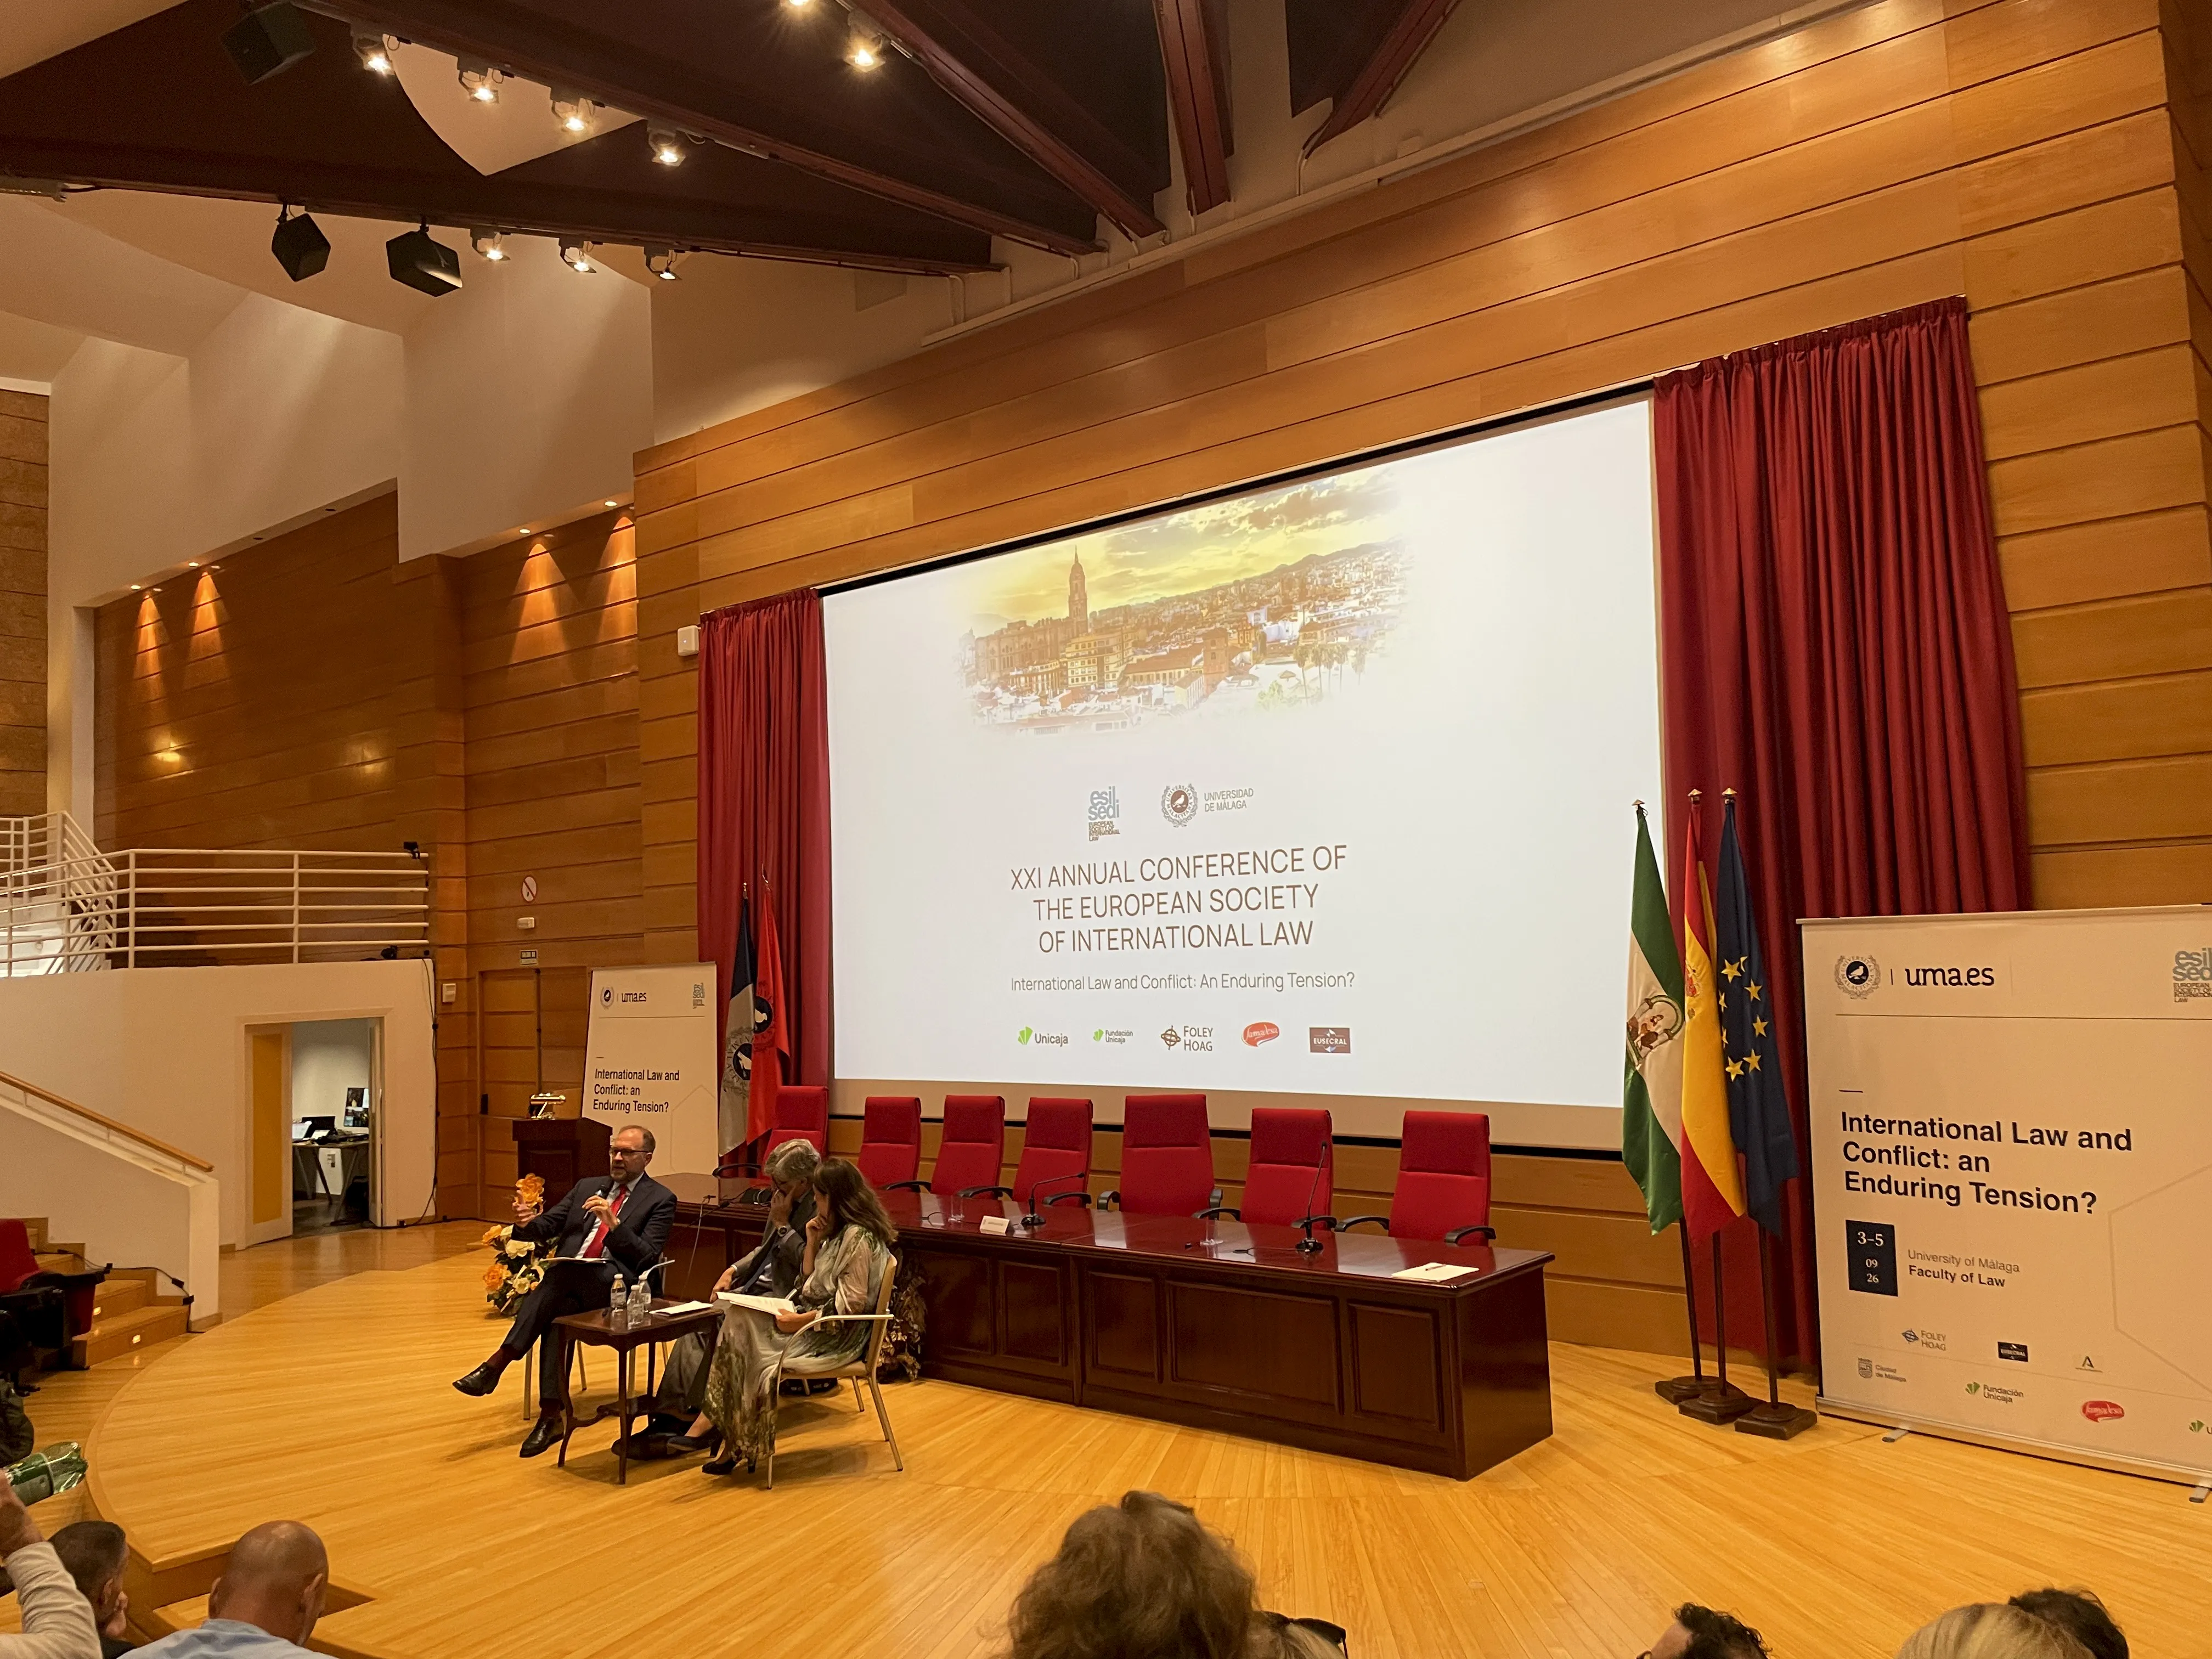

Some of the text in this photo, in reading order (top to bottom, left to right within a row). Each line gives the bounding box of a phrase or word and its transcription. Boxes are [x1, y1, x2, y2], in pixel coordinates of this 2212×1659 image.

[1090, 786, 1115, 806] esil
[1204, 788, 1254, 801] UNIVERSIDAD
[1088, 799, 1119, 821] sedi
[1205, 800, 1247, 812] DE MÁLAGA
[1011, 845, 1346, 890] XXI ANNUAL CONFERENCE OF
[1033, 884, 1318, 921] THE EUROPEAN SOCIETY
[1040, 921, 1313, 953] OF INTERNATIONAL LAW
[1011, 972, 1355, 992] International Law and Conflict: An Enduring Tension?
[1905, 967, 1995, 986] uma.es
[1183, 1025, 1213, 1037] FOLEY
[1035, 1033, 1068, 1047] Unicaja
[1105, 1035, 1126, 1045] Unicaja
[1184, 1041, 1213, 1052] HOAG
[595, 1068, 680, 1081] International Law and
[594, 1084, 640, 1096] Conflict: an
[593, 1099, 669, 1114] Enduring Tension?
[1841, 1111, 2132, 1151] International Law and
[1843, 1141, 1990, 1173] Conflict: an
[1845, 1170, 2097, 1214] Enduring Tension?
[1866, 1259, 1878, 1268] 09
[1908, 1249, 1962, 1267] University
[1964, 1256, 1975, 1267] of
[1866, 1273, 1879, 1284] 26
[1909, 1265, 2006, 1288] Faculty of Law
[1921, 1330, 1946, 1342] FOLEY
[1921, 1340, 1946, 1351] HOAG
[1983, 1384, 2024, 1398] Fundación
[1983, 1391, 2013, 1404] Unicaja
